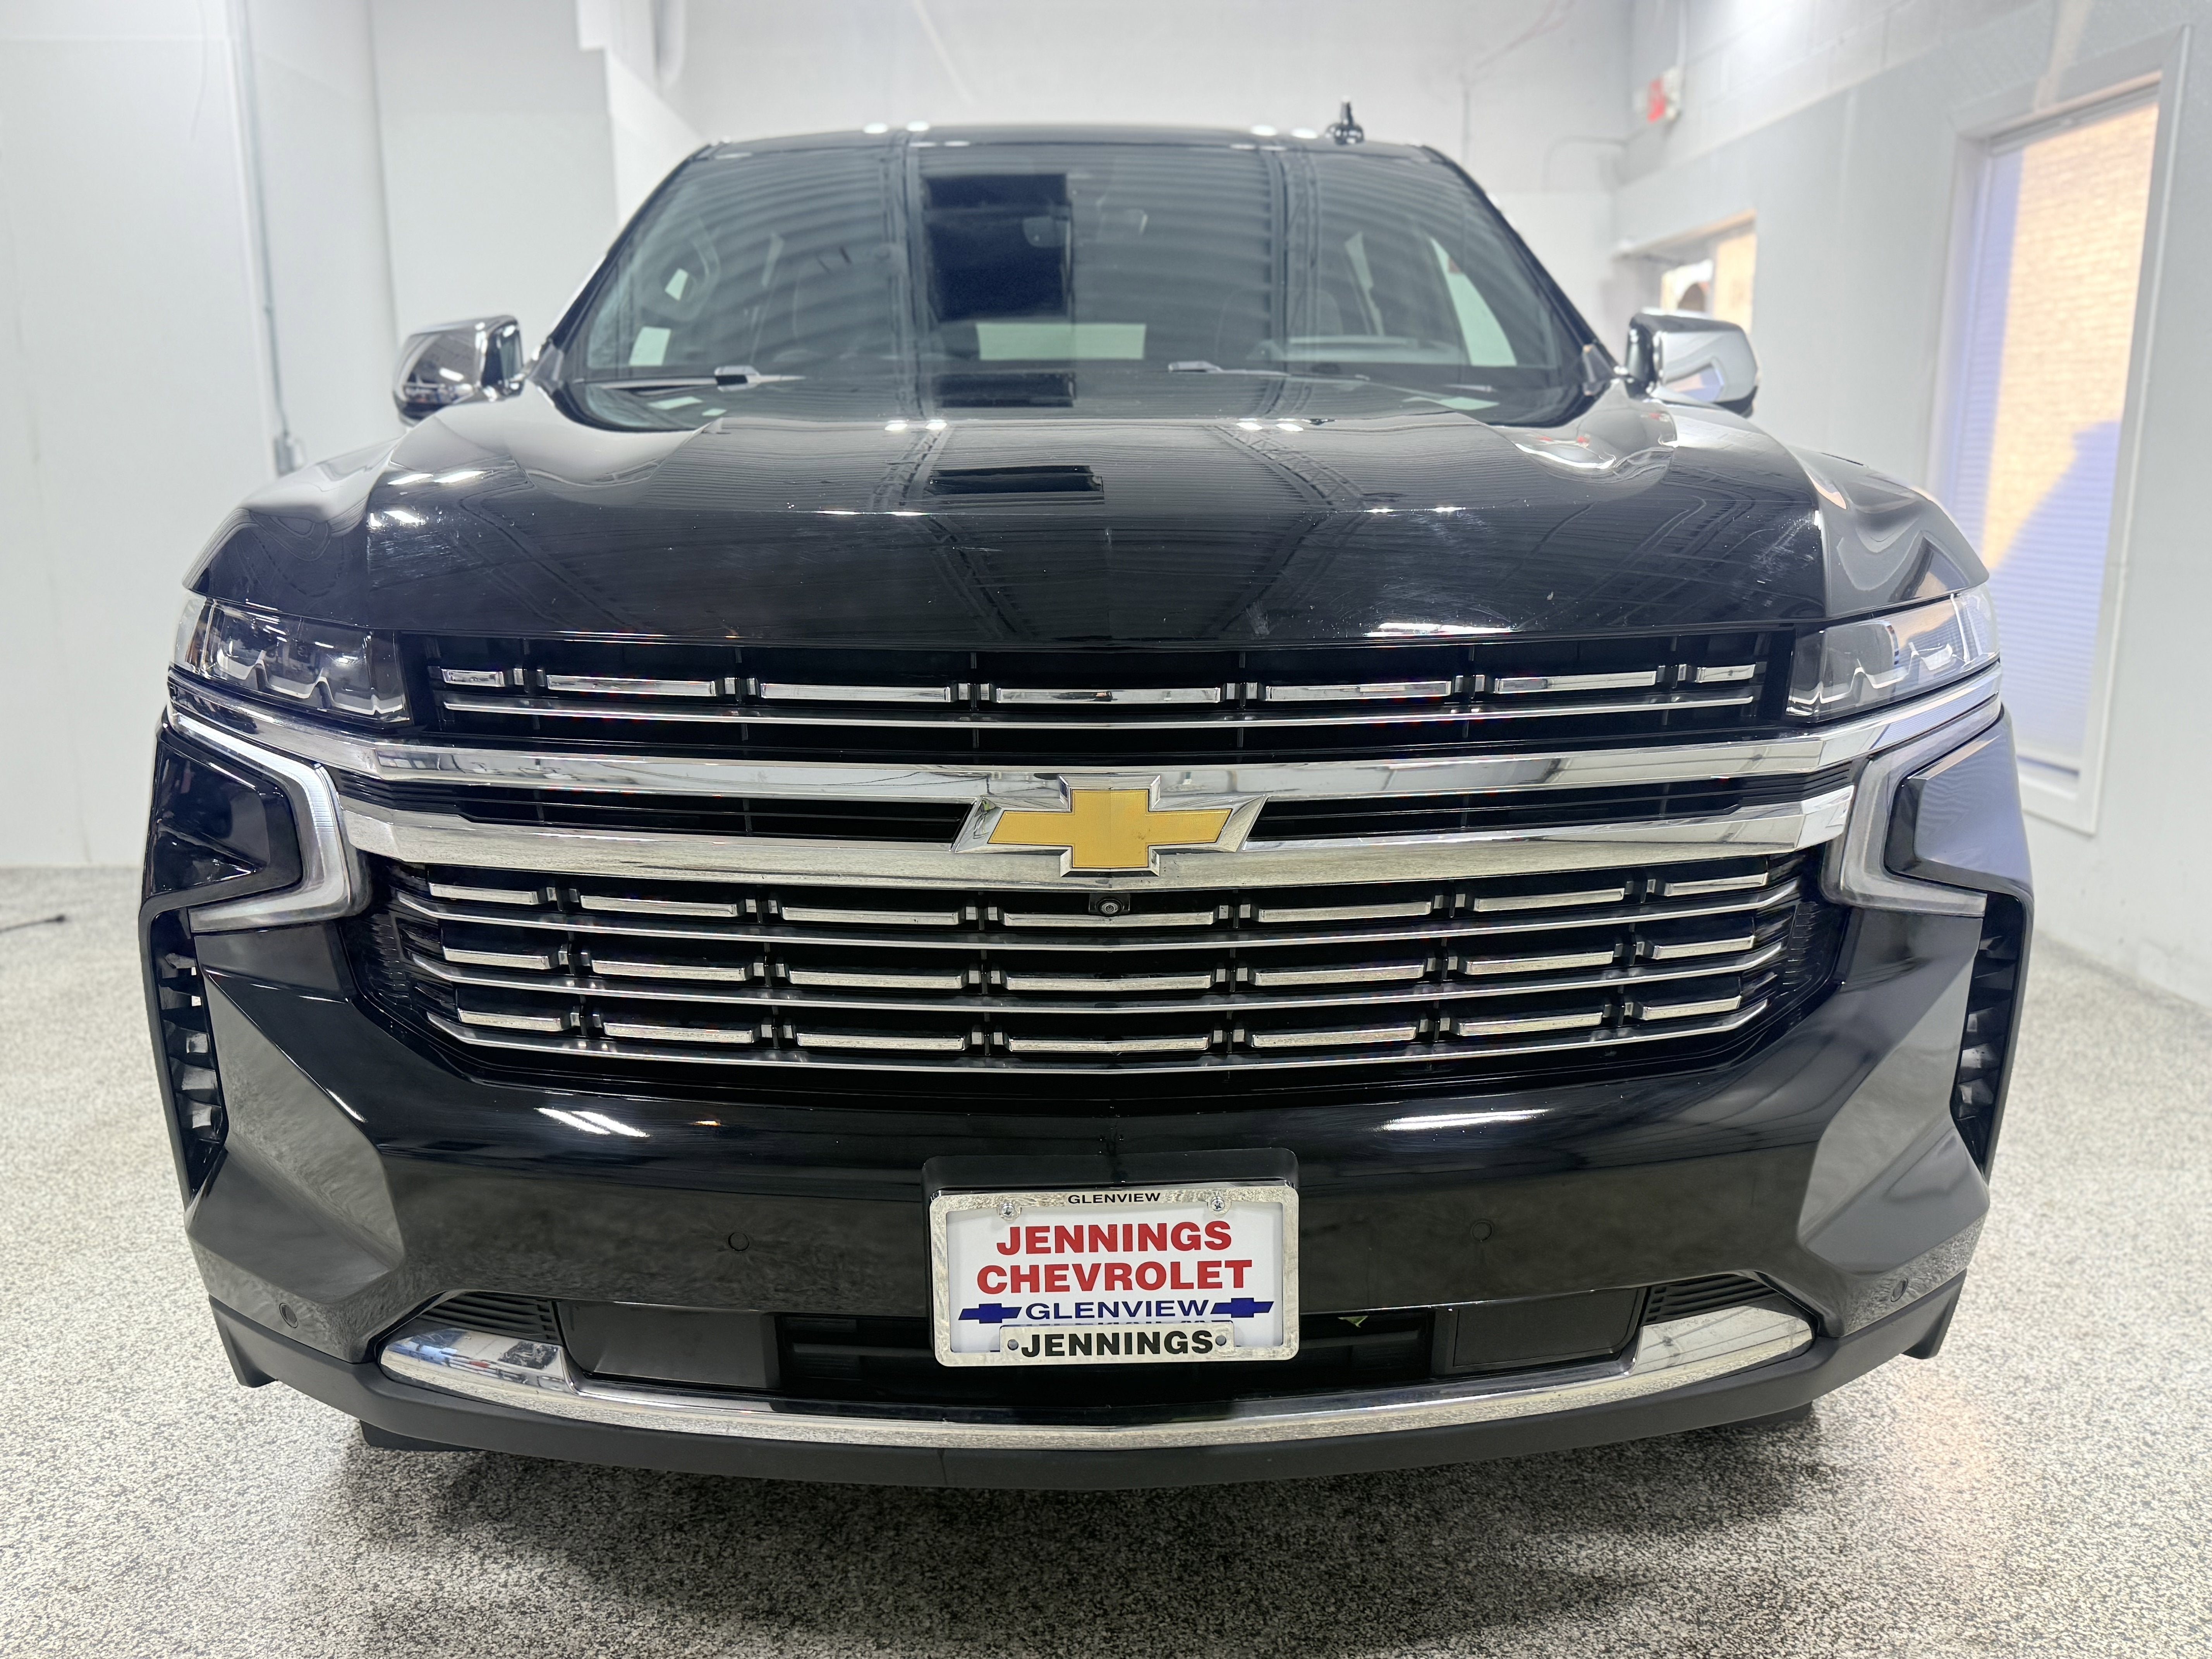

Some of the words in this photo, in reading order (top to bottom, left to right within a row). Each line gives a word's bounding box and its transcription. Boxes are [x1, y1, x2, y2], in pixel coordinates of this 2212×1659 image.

[1068, 1193, 1161, 1204] GLENVIEW
[996, 1220, 1232, 1255] JENNINGS
[977, 1259, 1252, 1295] CHEVROLET
[1025, 1300, 1209, 1320] GLENVIEW
[1021, 1330, 1213, 1357] JENNINGS
